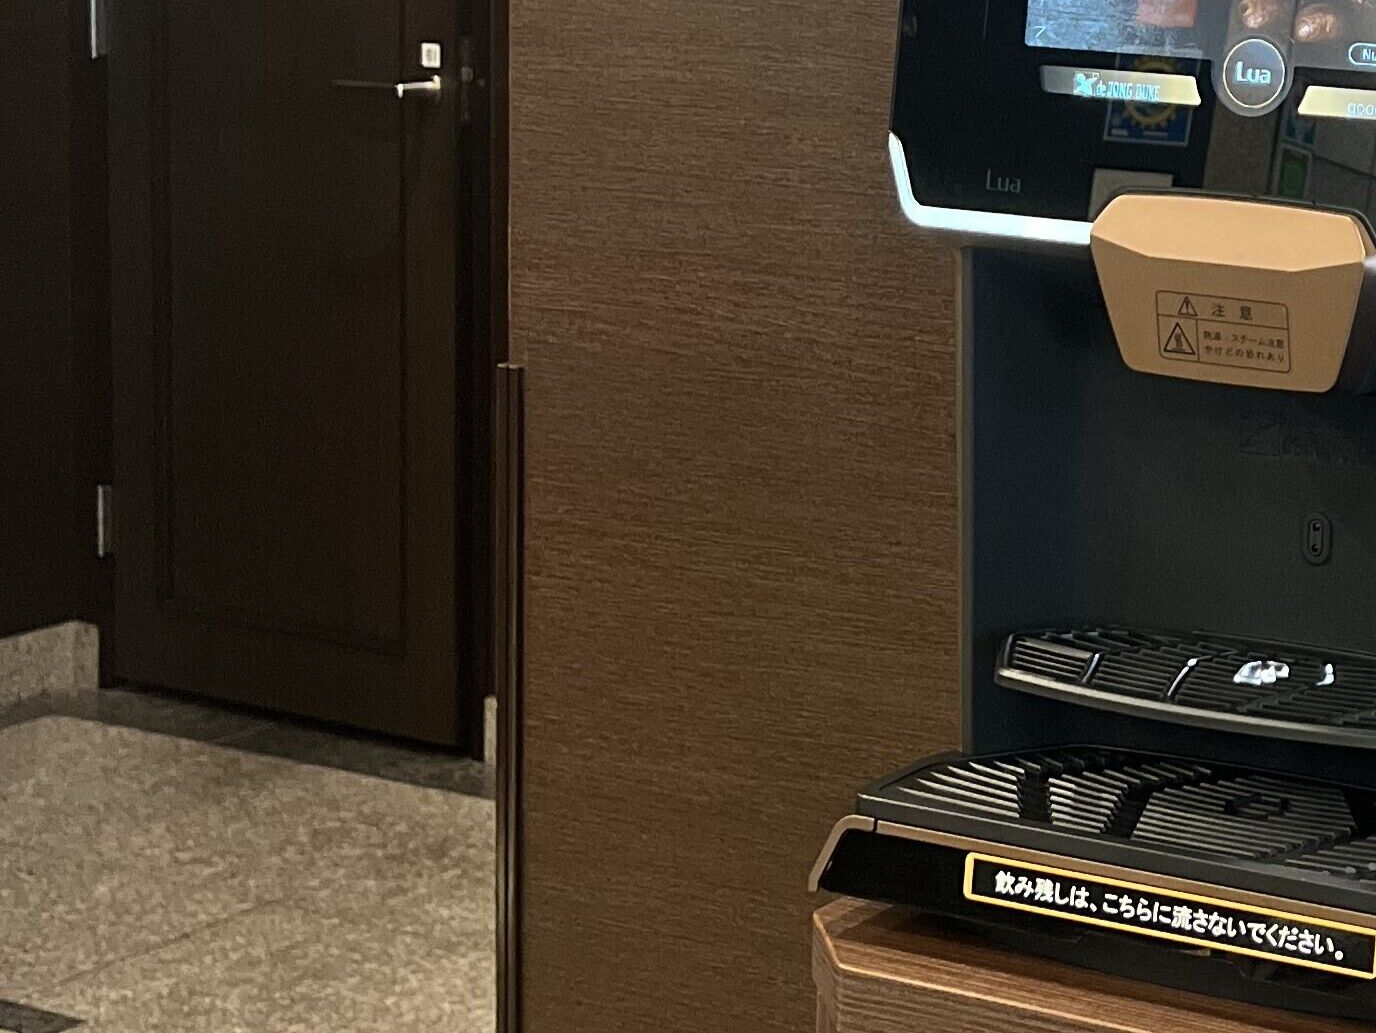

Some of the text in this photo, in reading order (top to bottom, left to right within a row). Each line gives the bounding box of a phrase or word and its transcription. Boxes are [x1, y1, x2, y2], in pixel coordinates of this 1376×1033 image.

[1234, 60, 1272, 86] Lua
[985, 168, 1022, 193] Lua
[994, 869, 1345, 962] 飲み残しは、こちらに流さないでください。
